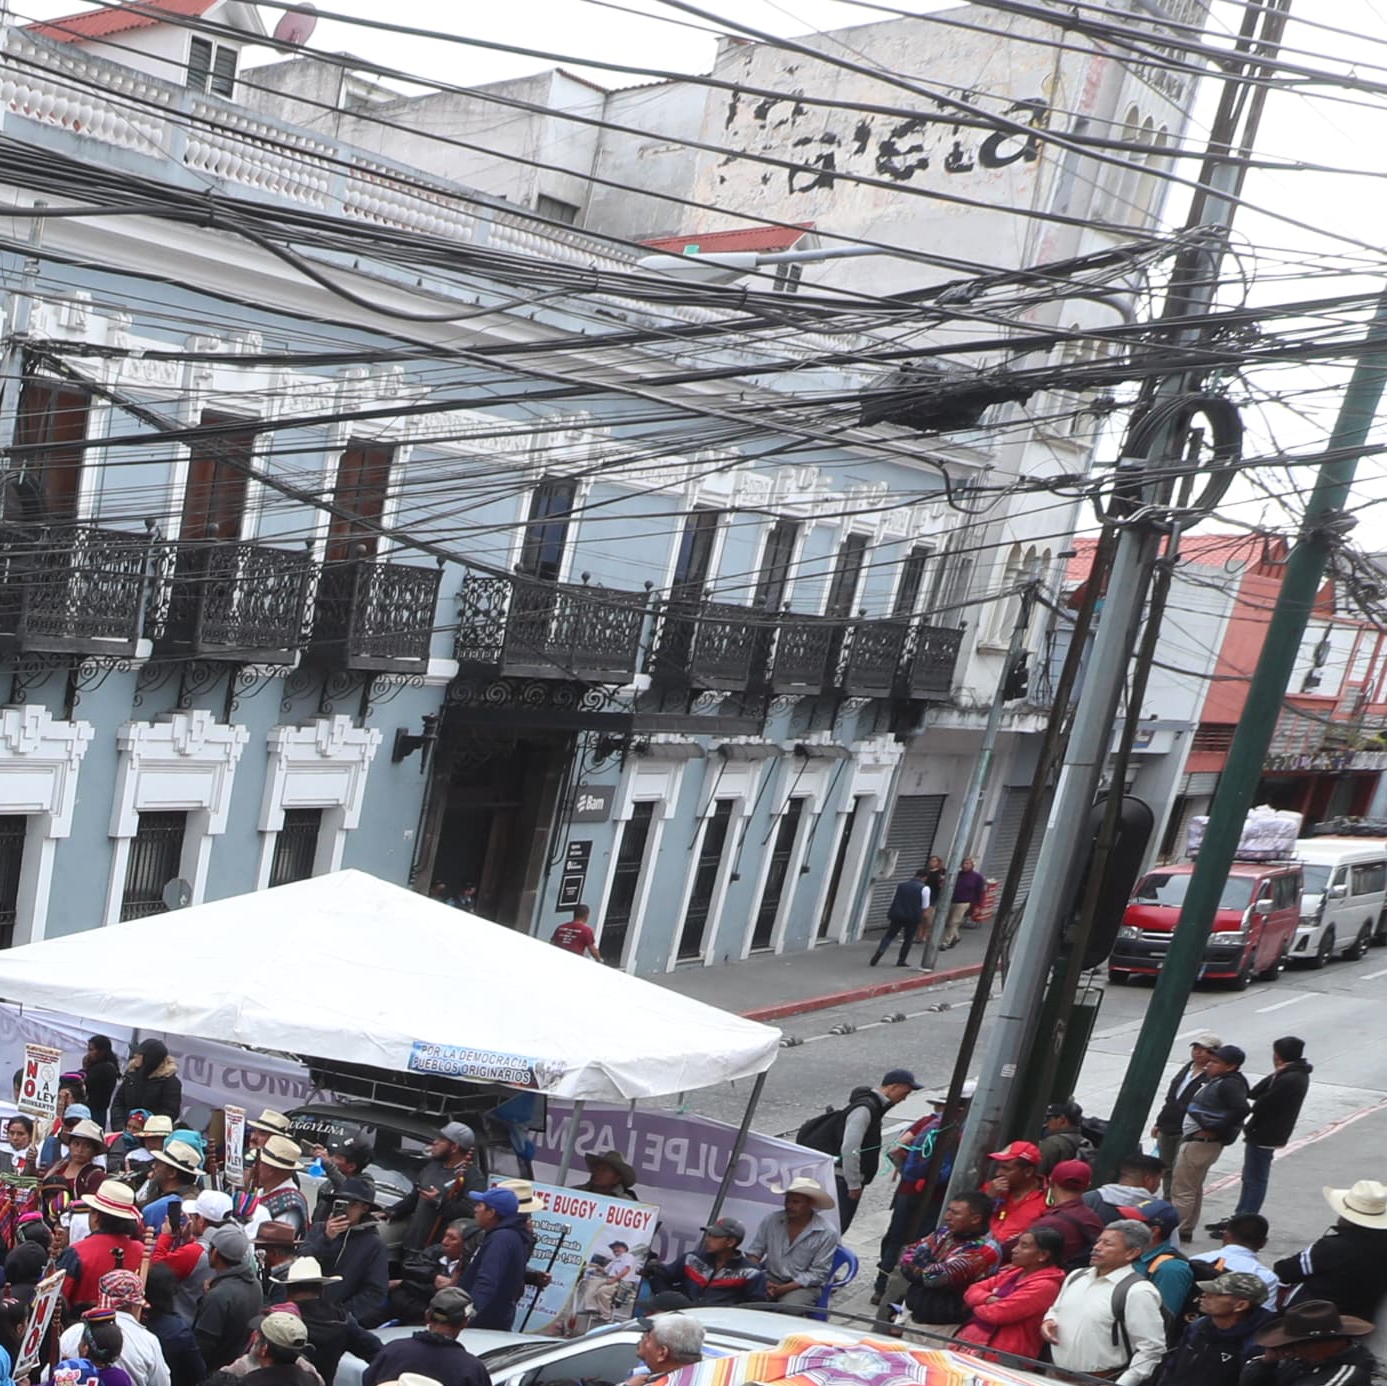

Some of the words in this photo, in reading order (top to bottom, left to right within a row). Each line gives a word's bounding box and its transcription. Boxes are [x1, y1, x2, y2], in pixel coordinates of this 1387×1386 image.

[585, 795, 604, 811] Bam
[421, 1044, 441, 1057] POR
[443, 1047, 456, 1059] LA
[458, 1048, 528, 1069] DEMOCRACIA
[412, 1056, 458, 1075] PUEBLOS
[461, 1063, 531, 1084] ORIGINARIOS
[36, 1090, 57, 1104] LEY
[289, 1120, 346, 1137] UGGYLINA
[553, 1195, 597, 1220] BUGGY
[606, 1205, 652, 1231] BUGGY
